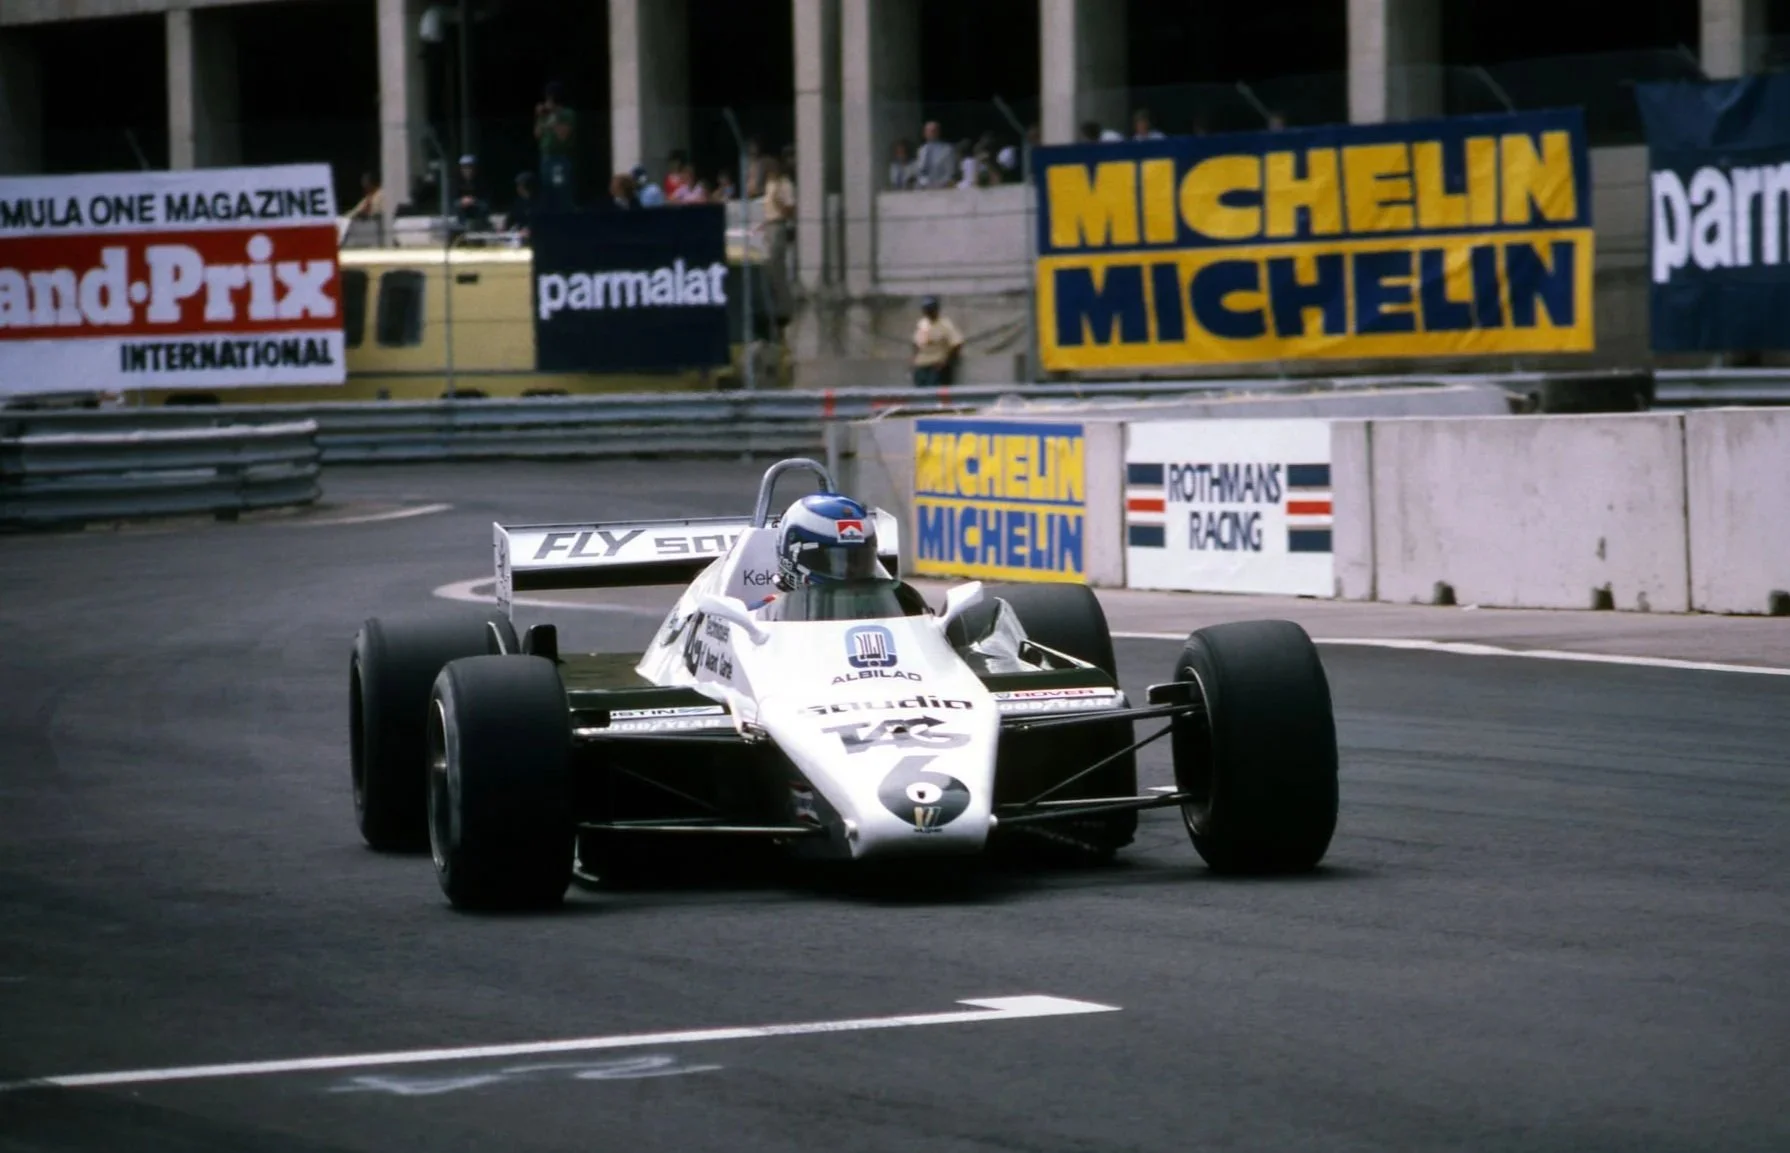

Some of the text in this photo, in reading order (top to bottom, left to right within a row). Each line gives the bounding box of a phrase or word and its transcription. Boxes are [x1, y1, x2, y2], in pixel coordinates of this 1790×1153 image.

[1, 188, 329, 228] MULA ONE MAGAZINE
[1046, 131, 1578, 248] MICHELIN
[538, 257, 728, 320] parmalat
[1053, 239, 1577, 347] MICHELIN
[121, 338, 335, 373] INTERNATIONAL
[915, 432, 1085, 502] MICHELIN
[1168, 462, 1281, 504] ROTHMANS
[532, 529, 648, 560] FLY
[917, 505, 1084, 573] MICHELIN
[1189, 510, 1263, 552] RACING
[831, 669, 923, 685] ALBILAD
[1013, 688, 1095, 699] ROVER
[877, 755, 972, 828] 6
